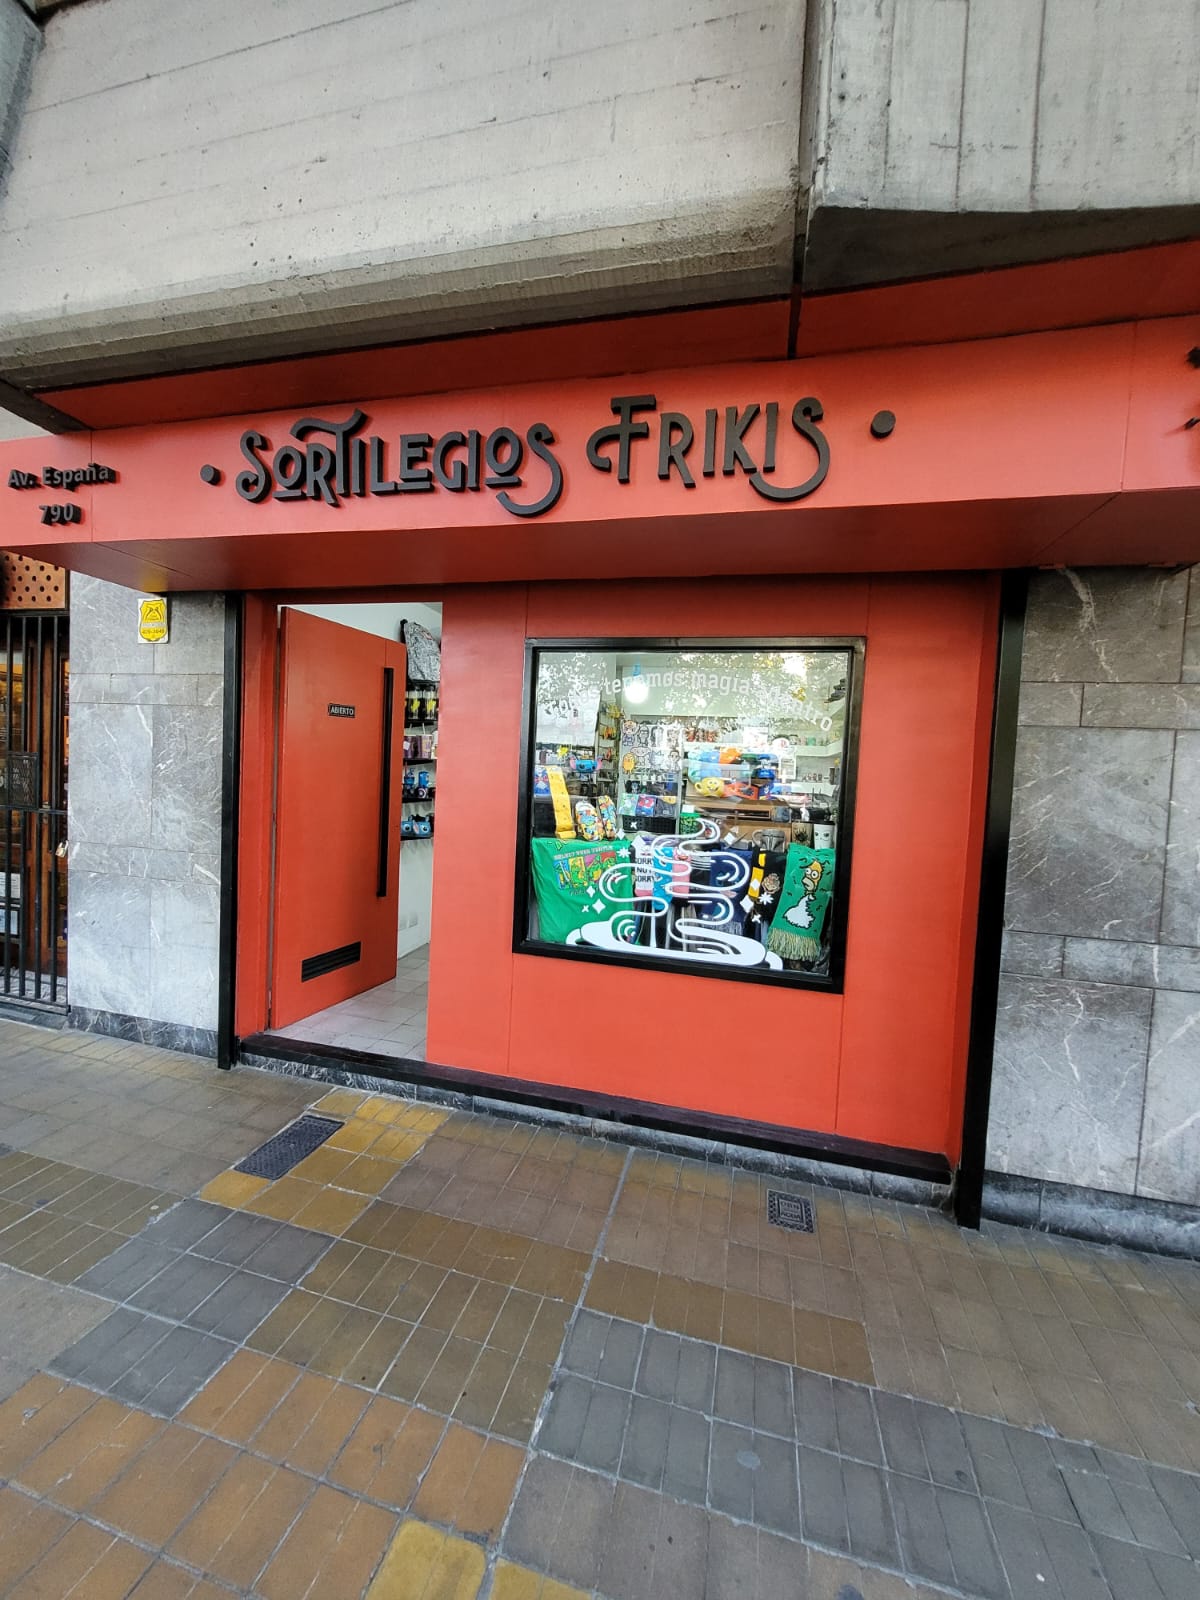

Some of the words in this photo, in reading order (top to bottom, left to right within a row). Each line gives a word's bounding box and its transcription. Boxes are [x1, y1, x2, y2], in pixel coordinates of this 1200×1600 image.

[586, 394, 831, 503] FRIKIS
[8, 469, 40, 490] Av.
[42, 463, 115, 491] España
[39, 503, 81, 525] 790
[691, 671, 750, 696] magia
[330, 706, 354, 716] ABIERTO
